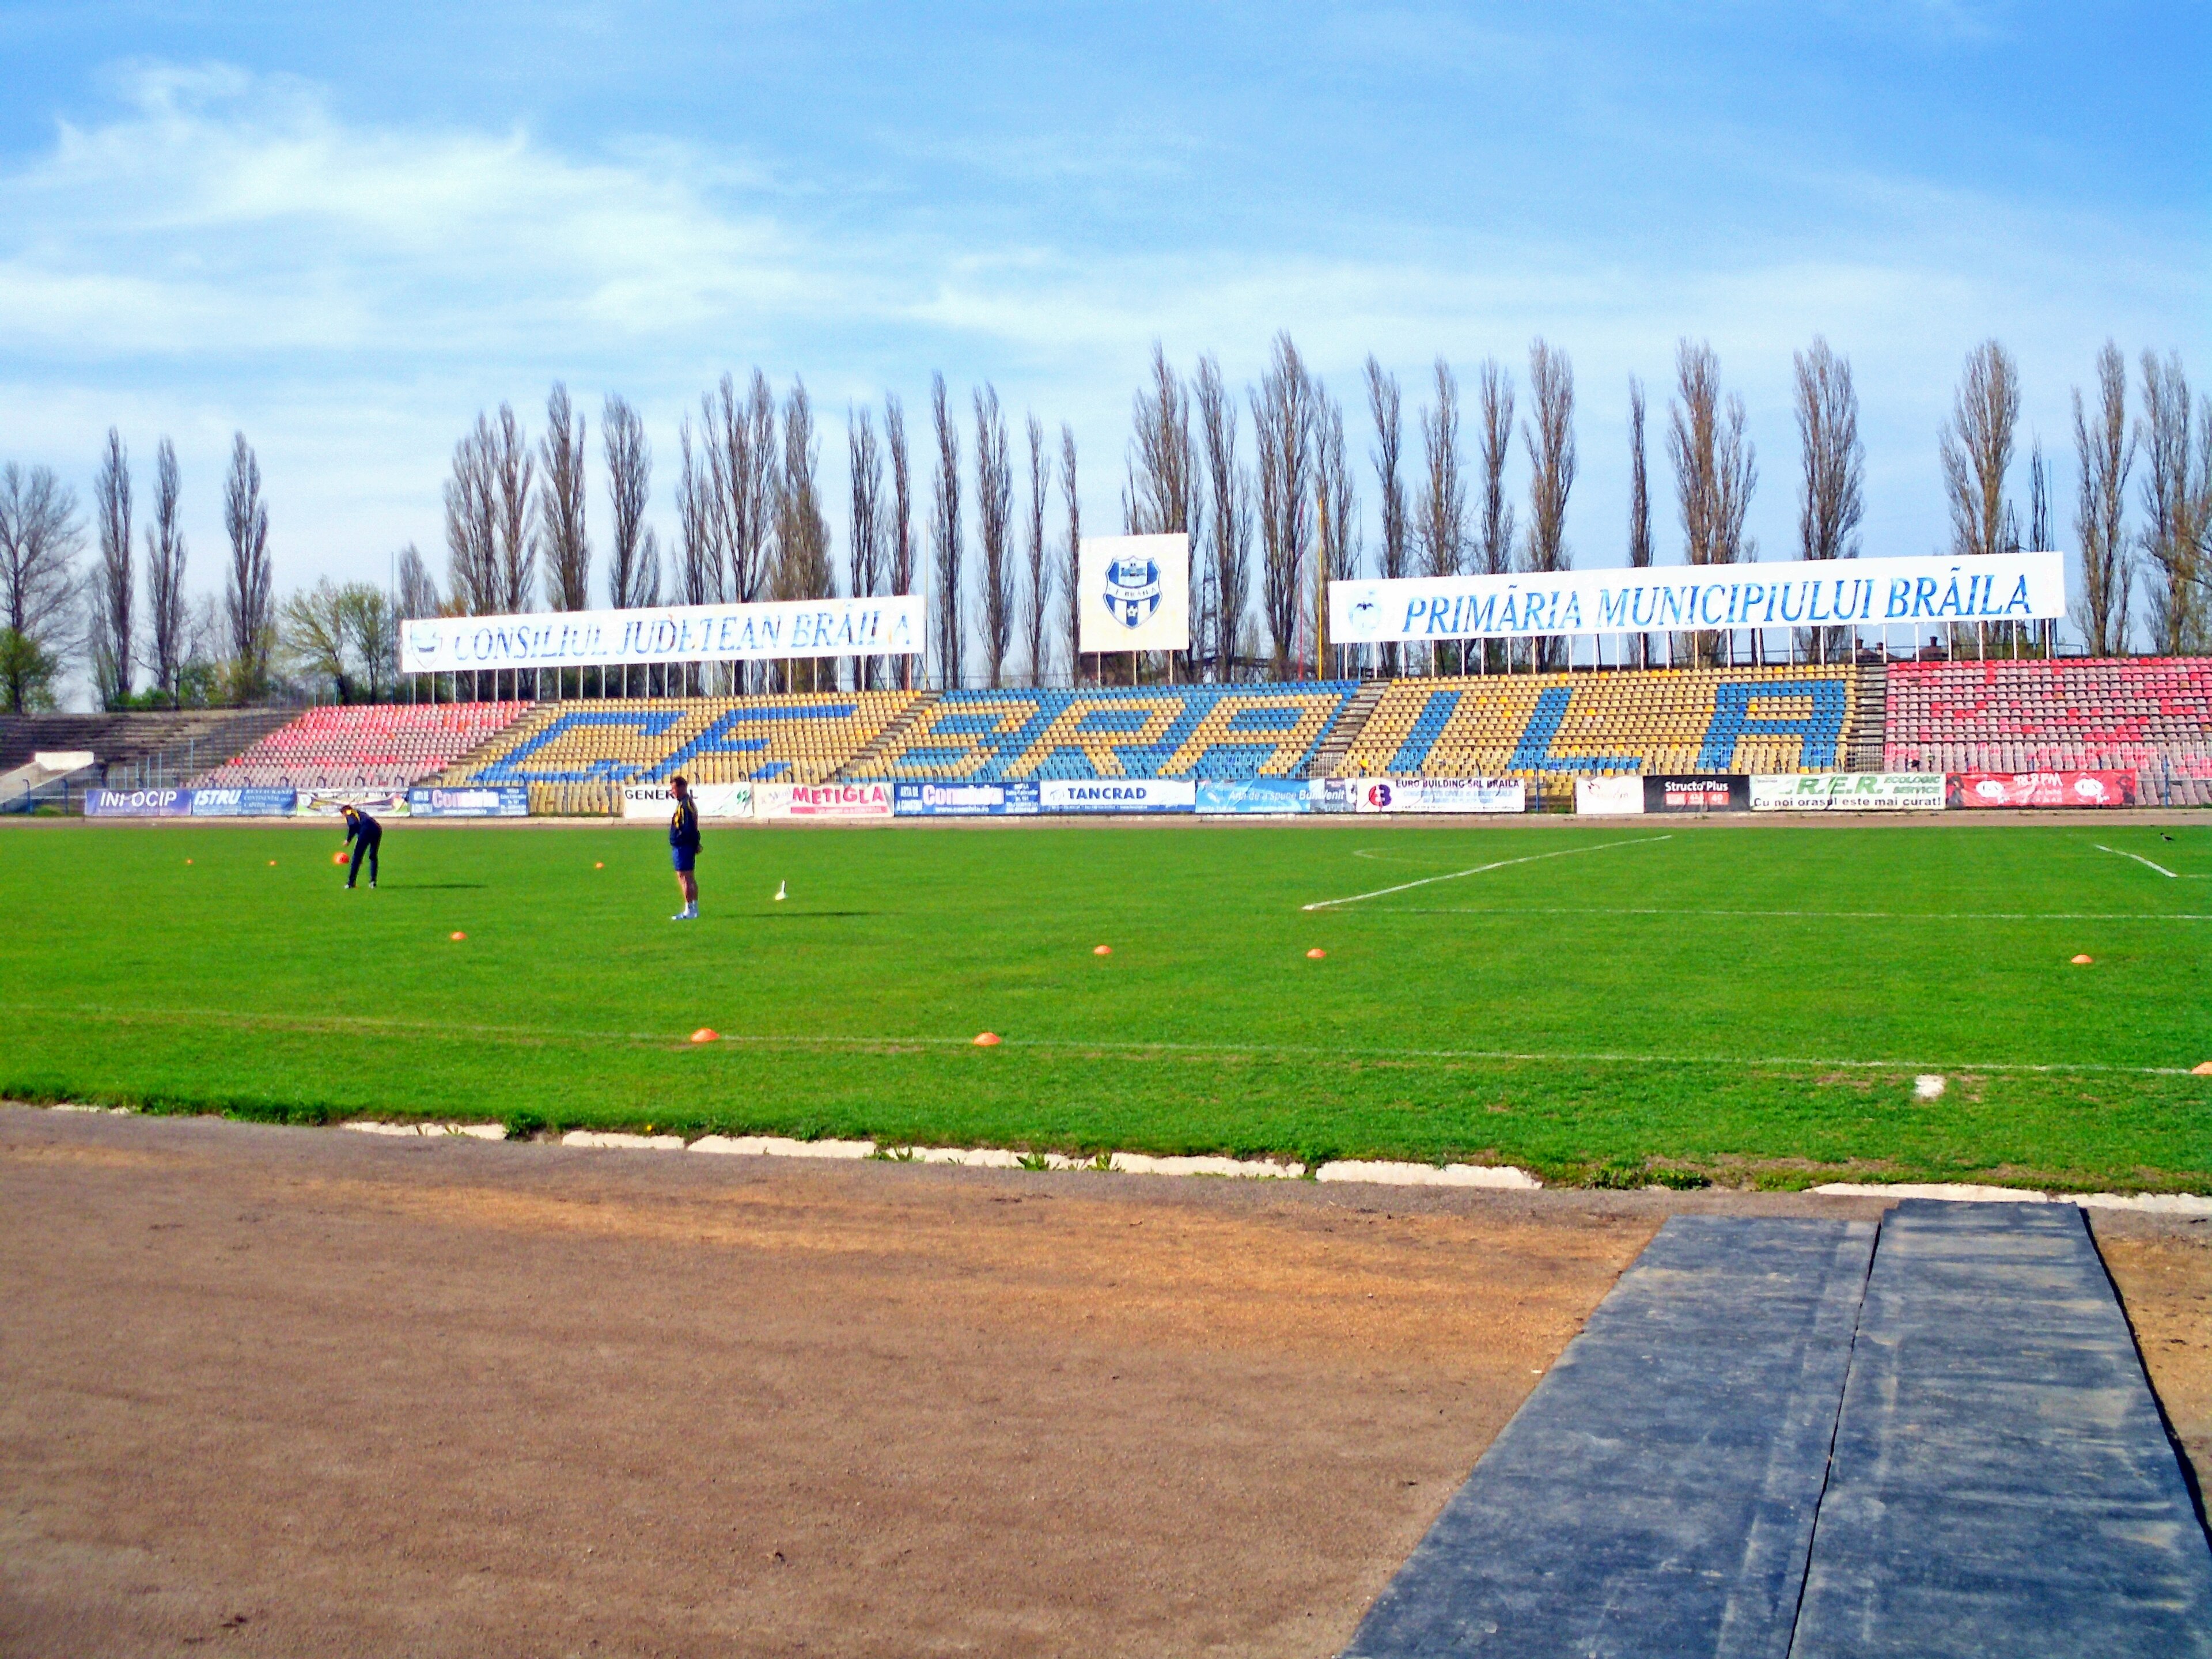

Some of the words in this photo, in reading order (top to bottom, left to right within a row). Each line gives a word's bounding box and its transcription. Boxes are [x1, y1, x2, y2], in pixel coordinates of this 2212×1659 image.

[1597, 578, 1874, 626] MUNICIPIULUI
[455, 624, 608, 661] CONSILIUL
[1396, 779, 1420, 788] EURO
[1423, 779, 1465, 789] BUILDING
[1487, 779, 1520, 789] BRAILA
[1706, 780, 1729, 791] Plus
[624, 789, 699, 800] GENERL
[792, 785, 887, 805] METIGLA
[1067, 787, 1147, 800] TANCRAD
[1754, 798, 1770, 806] Cu
[1775, 797, 1793, 806] noi
[1842, 798, 1870, 806] este
[1874, 797, 1898, 806] mai
[1903, 797, 1941, 806] curat!
